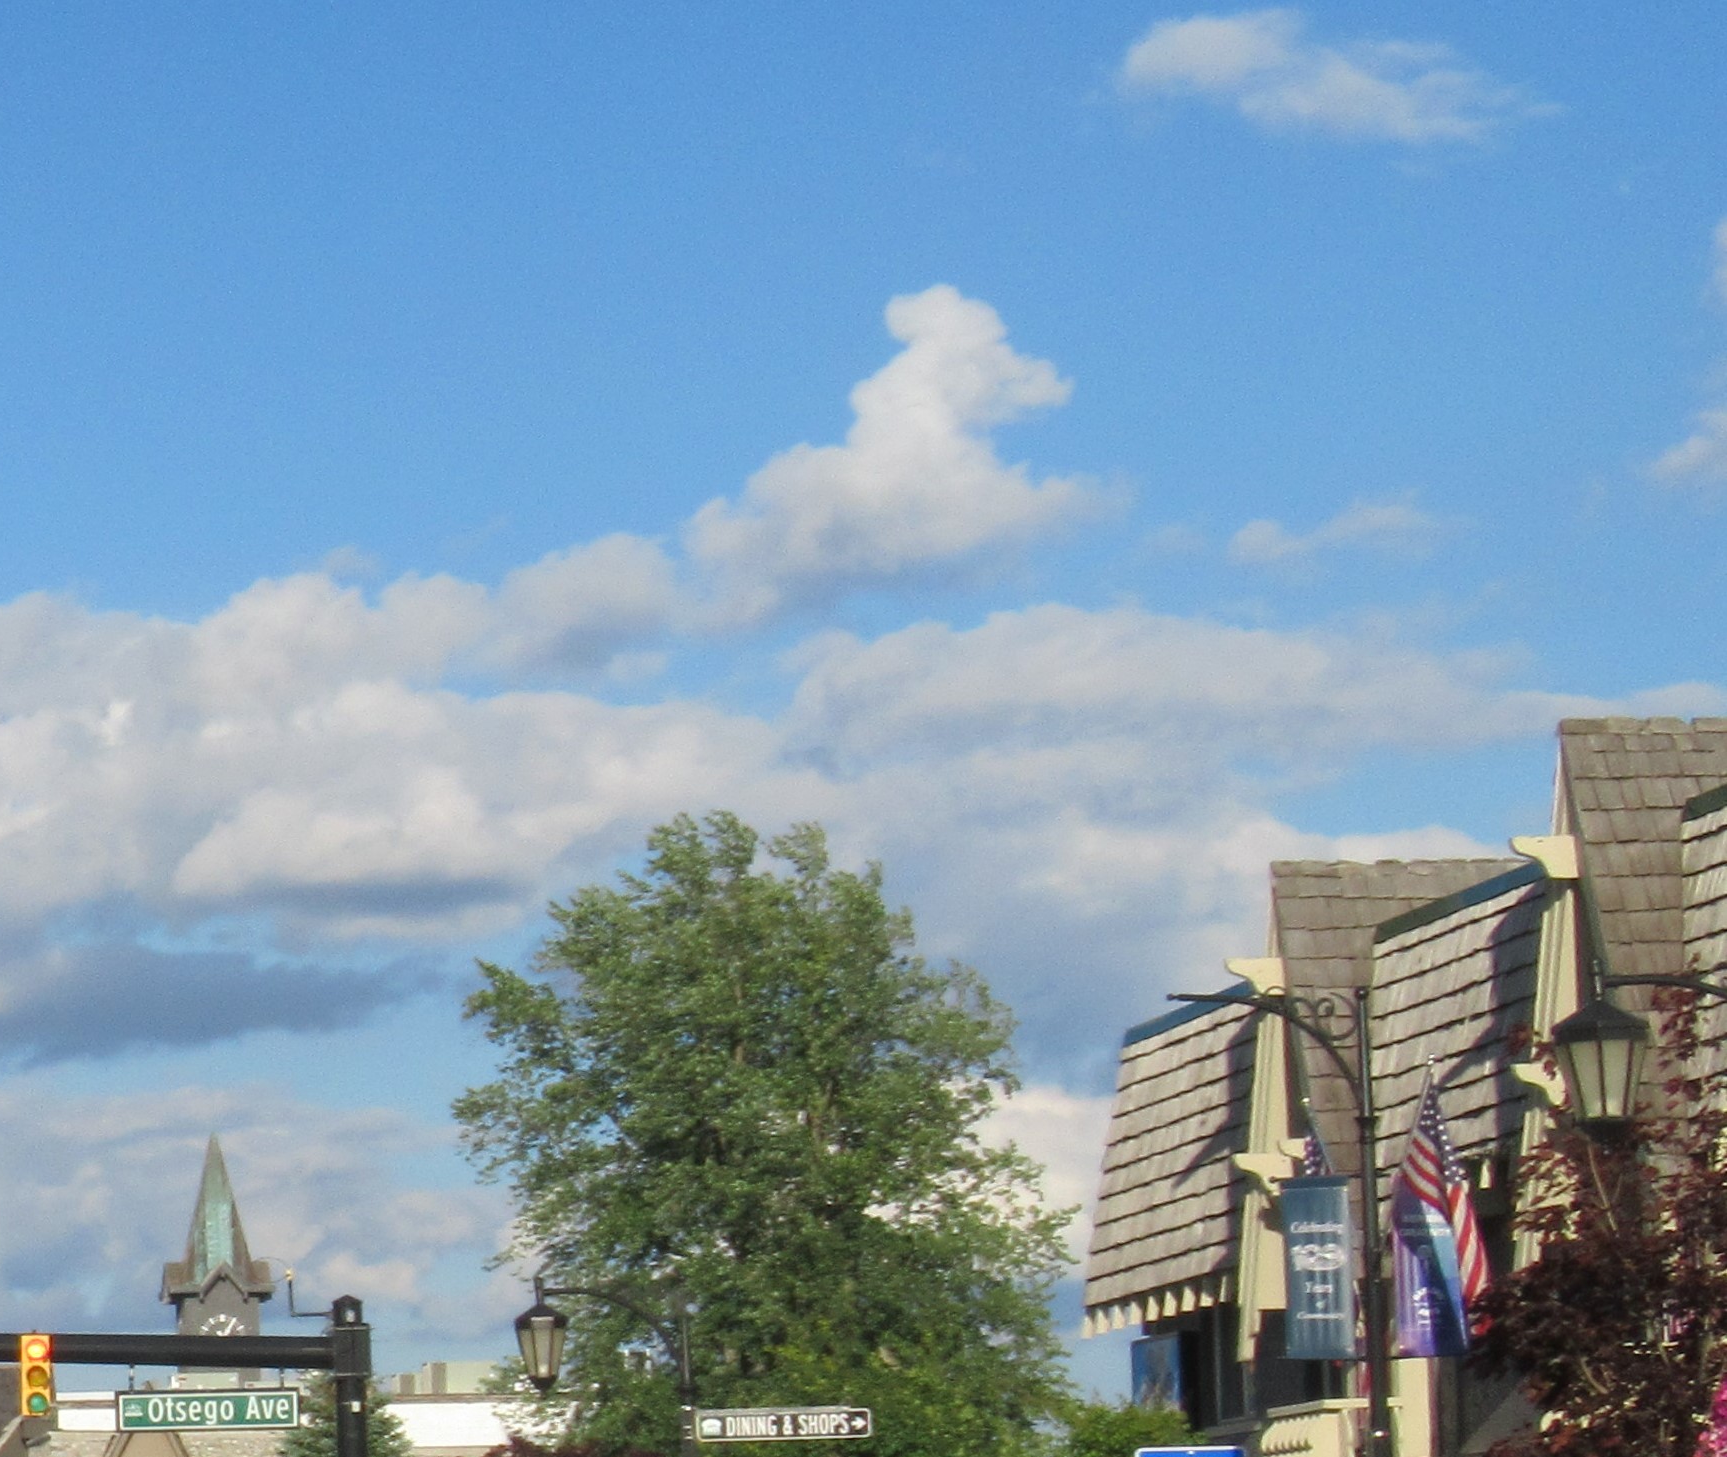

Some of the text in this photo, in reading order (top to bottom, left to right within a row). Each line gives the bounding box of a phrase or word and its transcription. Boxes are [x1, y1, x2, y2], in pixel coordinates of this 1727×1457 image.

[148, 1395, 290, 1426] Otsego Ave
[725, 1412, 850, 1437] DINING & SHOPS
